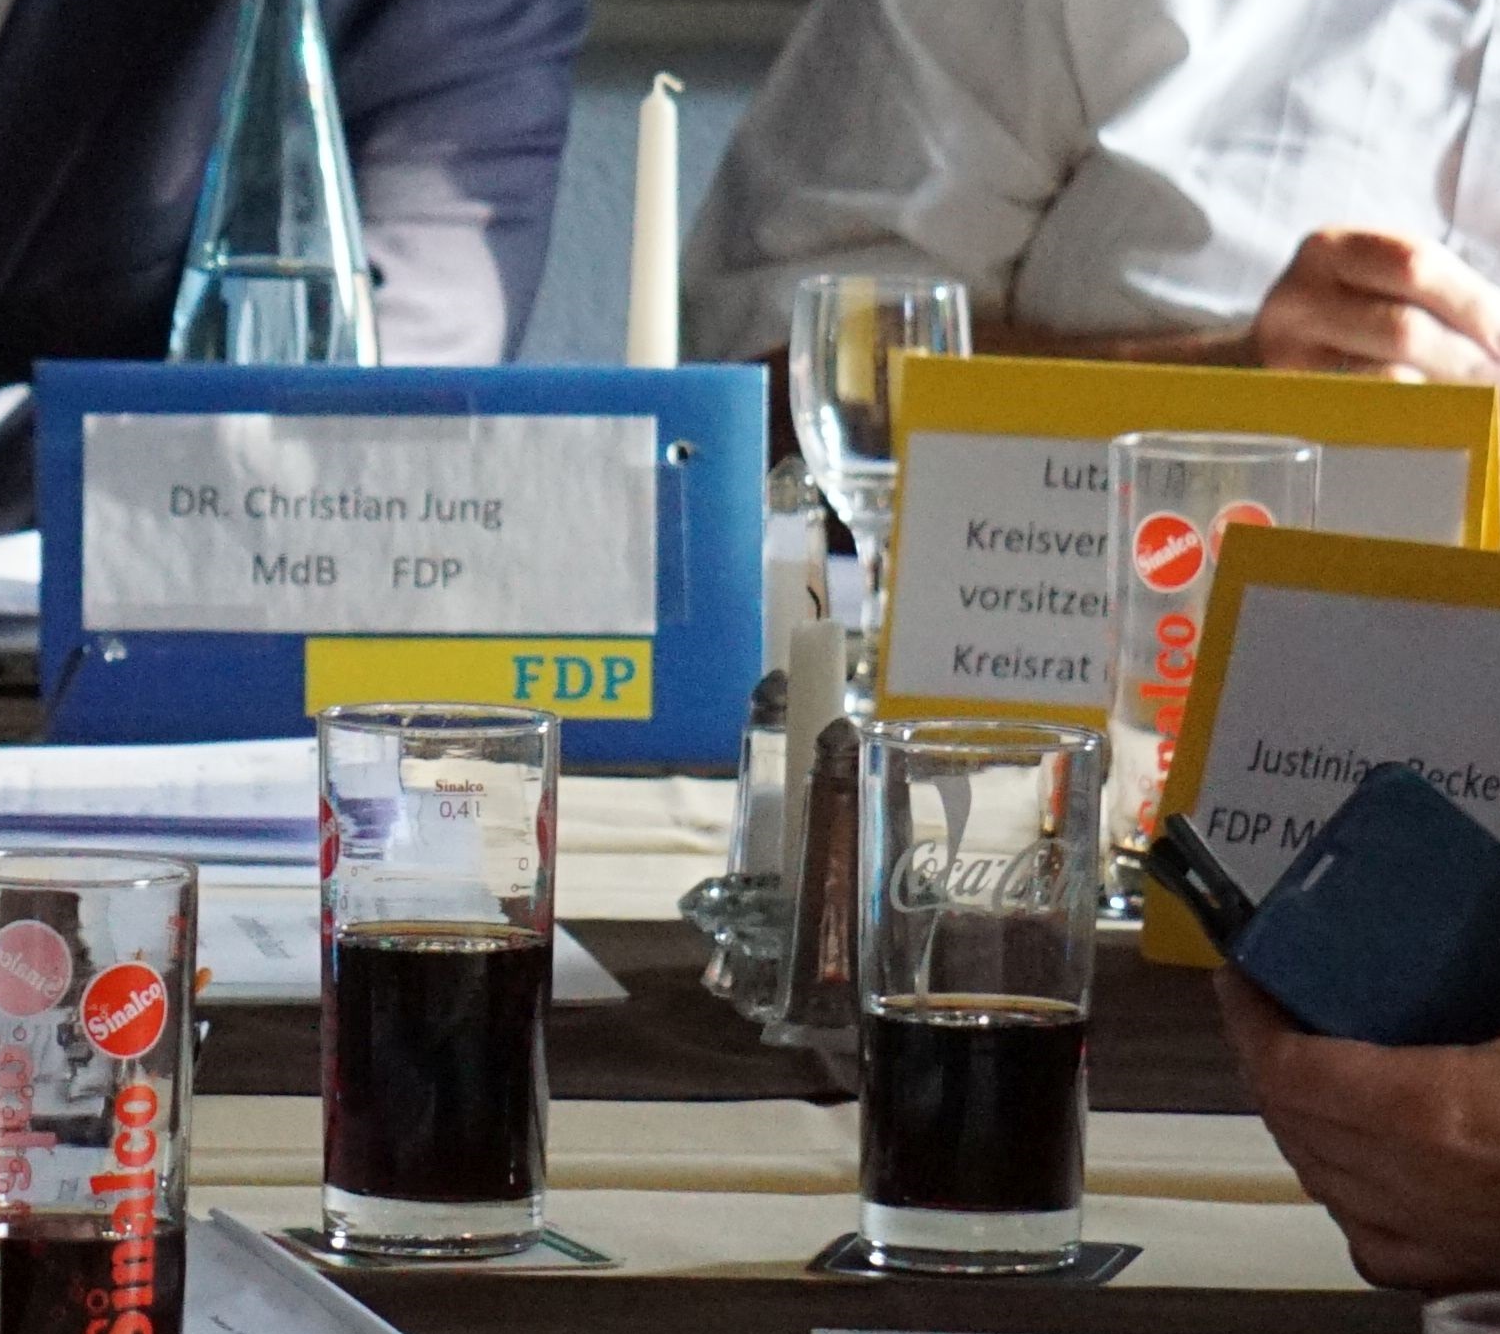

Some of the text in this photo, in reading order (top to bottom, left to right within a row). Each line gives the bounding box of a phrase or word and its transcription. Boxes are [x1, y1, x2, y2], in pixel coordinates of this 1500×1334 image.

[169, 484, 503, 530] DR. Christian Jung
[968, 520, 1108, 557] Kreisver
[252, 553, 463, 588] MdB FDP
[512, 656, 636, 701] FDP
[954, 645, 1092, 683] Kreisrat
[1248, 740, 1372, 786] Justinia
[435, 778, 484, 793] Sinalco
[1207, 808, 1270, 844] FDP
[89, 982, 162, 1043] Sinalco
